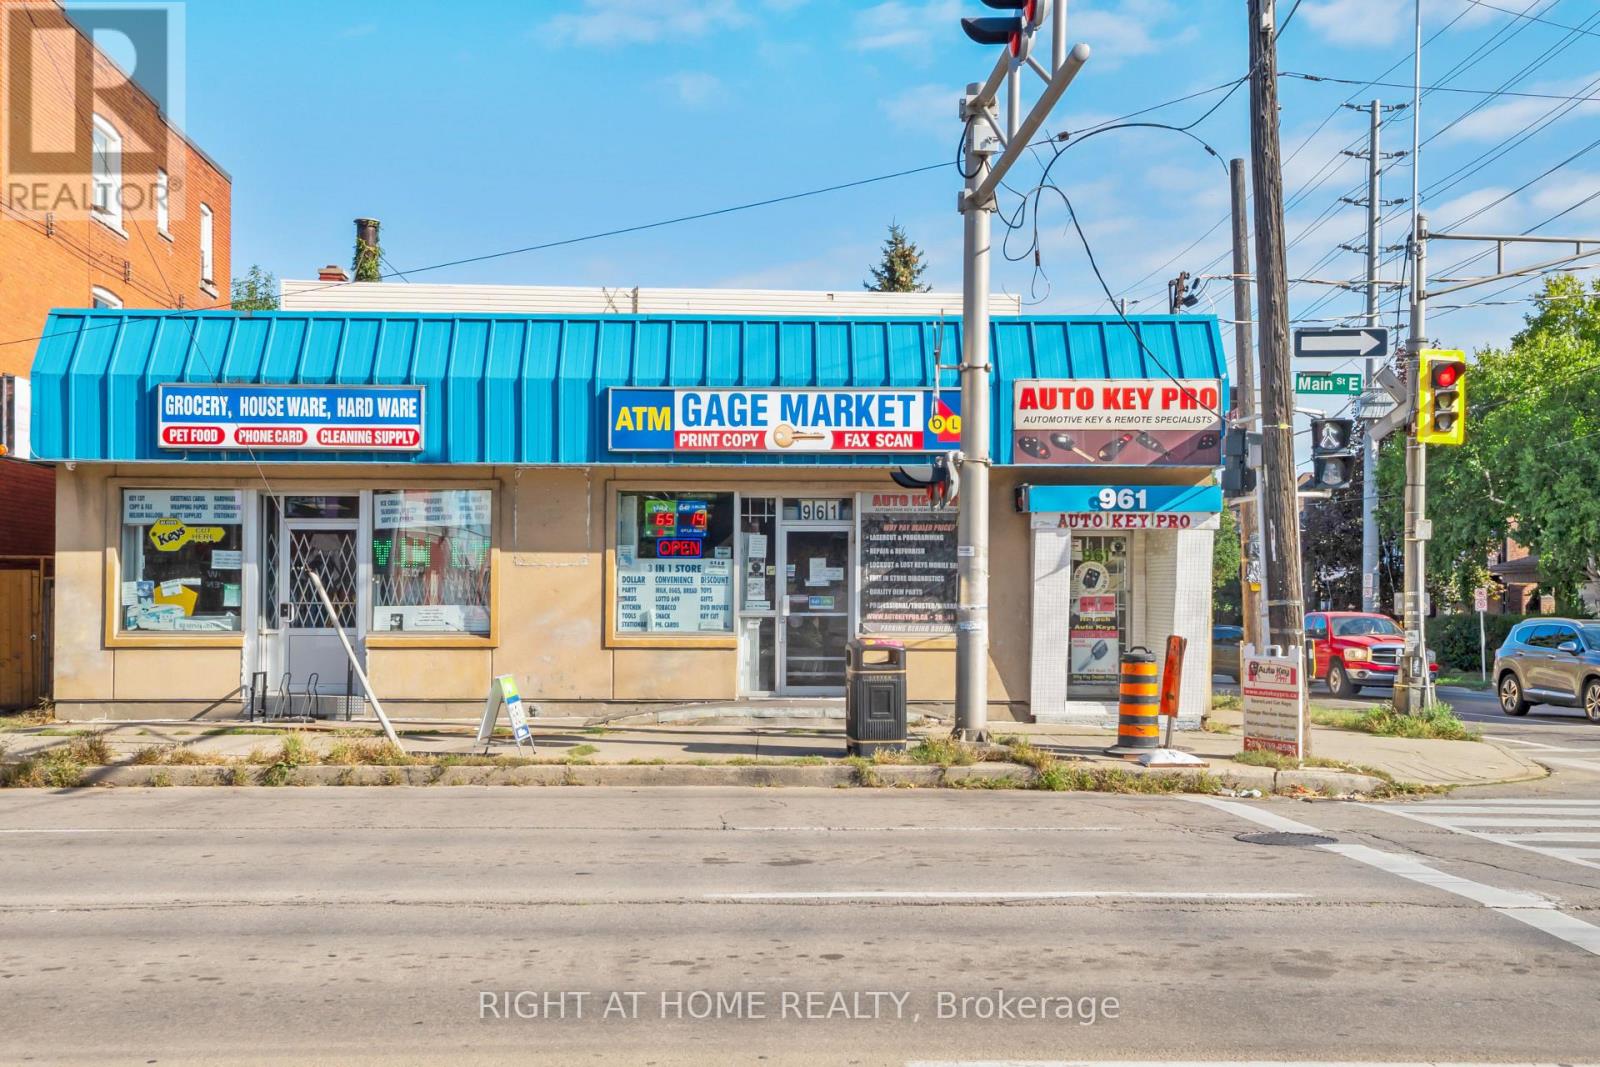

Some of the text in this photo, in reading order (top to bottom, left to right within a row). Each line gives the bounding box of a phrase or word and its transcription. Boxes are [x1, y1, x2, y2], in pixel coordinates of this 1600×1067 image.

[1298, 377, 1359, 391] Main St E
[1019, 387, 1217, 410] AUTO KEY PRO
[165, 394, 417, 420] GROCERY, HOUSE WARE, HARD WARE
[682, 393, 916, 427] GAGE MARKET
[615, 406, 671, 431] ATM
[1023, 415, 1213, 424] AUTOMOTIVE KEY & REMOTE SPECIALISTS
[169, 429, 218, 442] PET FOOD
[239, 429, 303, 443] PHONE CARD
[320, 430, 415, 445] CLEANING SUPPLY
[679, 433, 759, 447] PRINT COPY
[844, 433, 913, 447] FAX SCAN
[872, 494, 908, 507] AUTO
[1098, 488, 1147, 510] 961
[656, 512, 674, 526] 65
[803, 504, 836, 520] 961
[1058, 513, 1191, 529] AUTO KEY PRO
[157, 527, 186, 545] Keys
[660, 540, 700, 556] OPEN
[648, 563, 702, 573] 3 IN 1 STORE
[621, 576, 646, 584] DOLLAR
[655, 576, 694, 584] CONVENIENCE
[700, 576, 729, 584] DISCOUNT
[1258, 666, 1276, 675] Auto
